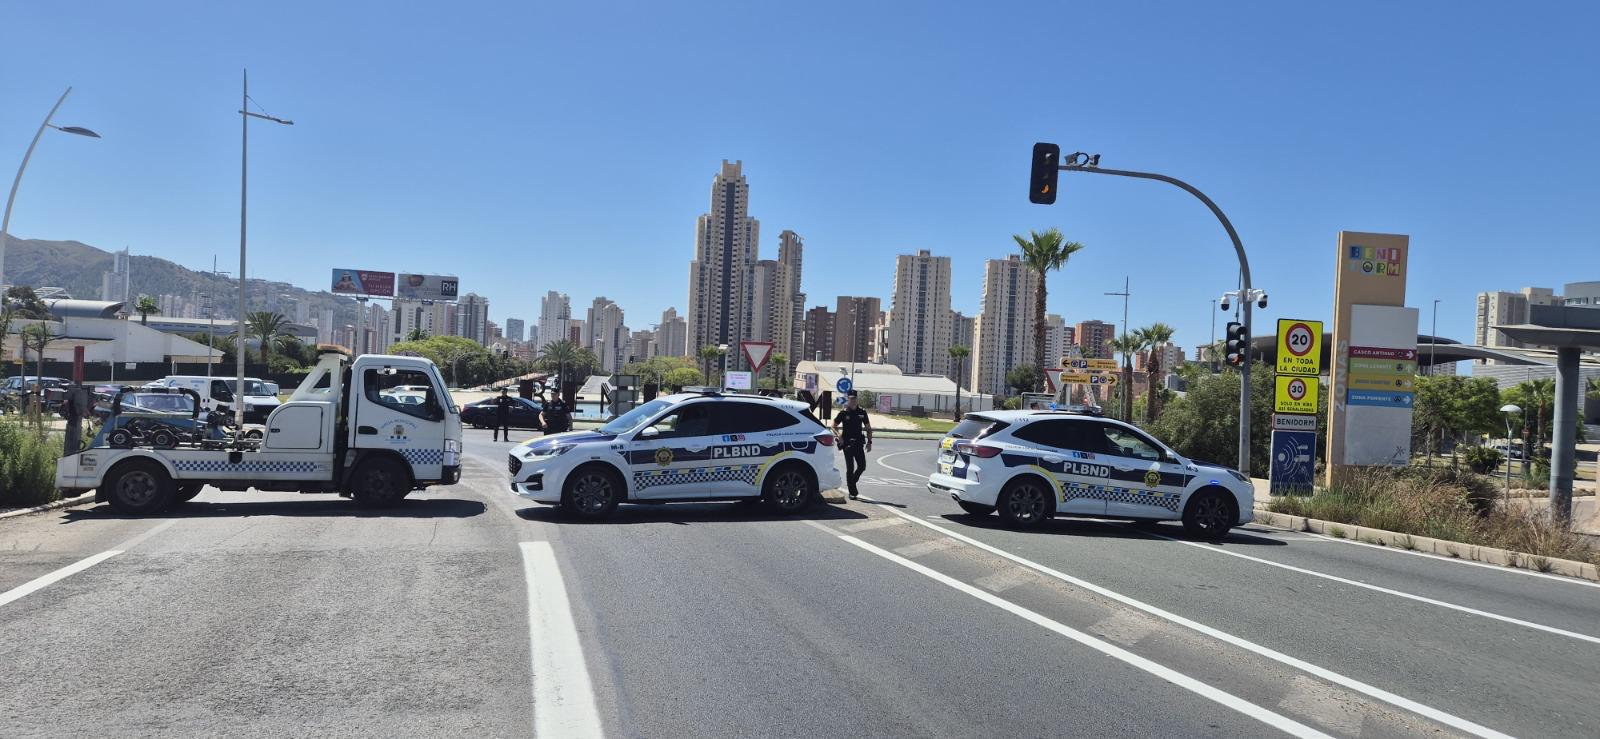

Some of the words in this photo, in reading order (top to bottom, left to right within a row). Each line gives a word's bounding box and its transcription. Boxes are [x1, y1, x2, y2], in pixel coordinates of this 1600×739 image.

[442, 282, 457, 292] RH
[1291, 334, 1308, 345] 20
[1291, 365, 1316, 373] CIUDAD
[1291, 385, 1303, 394] 30
[1276, 418, 1315, 426] BENIDORM
[713, 445, 761, 458] PLBND
[1063, 462, 1109, 477] PLBND
